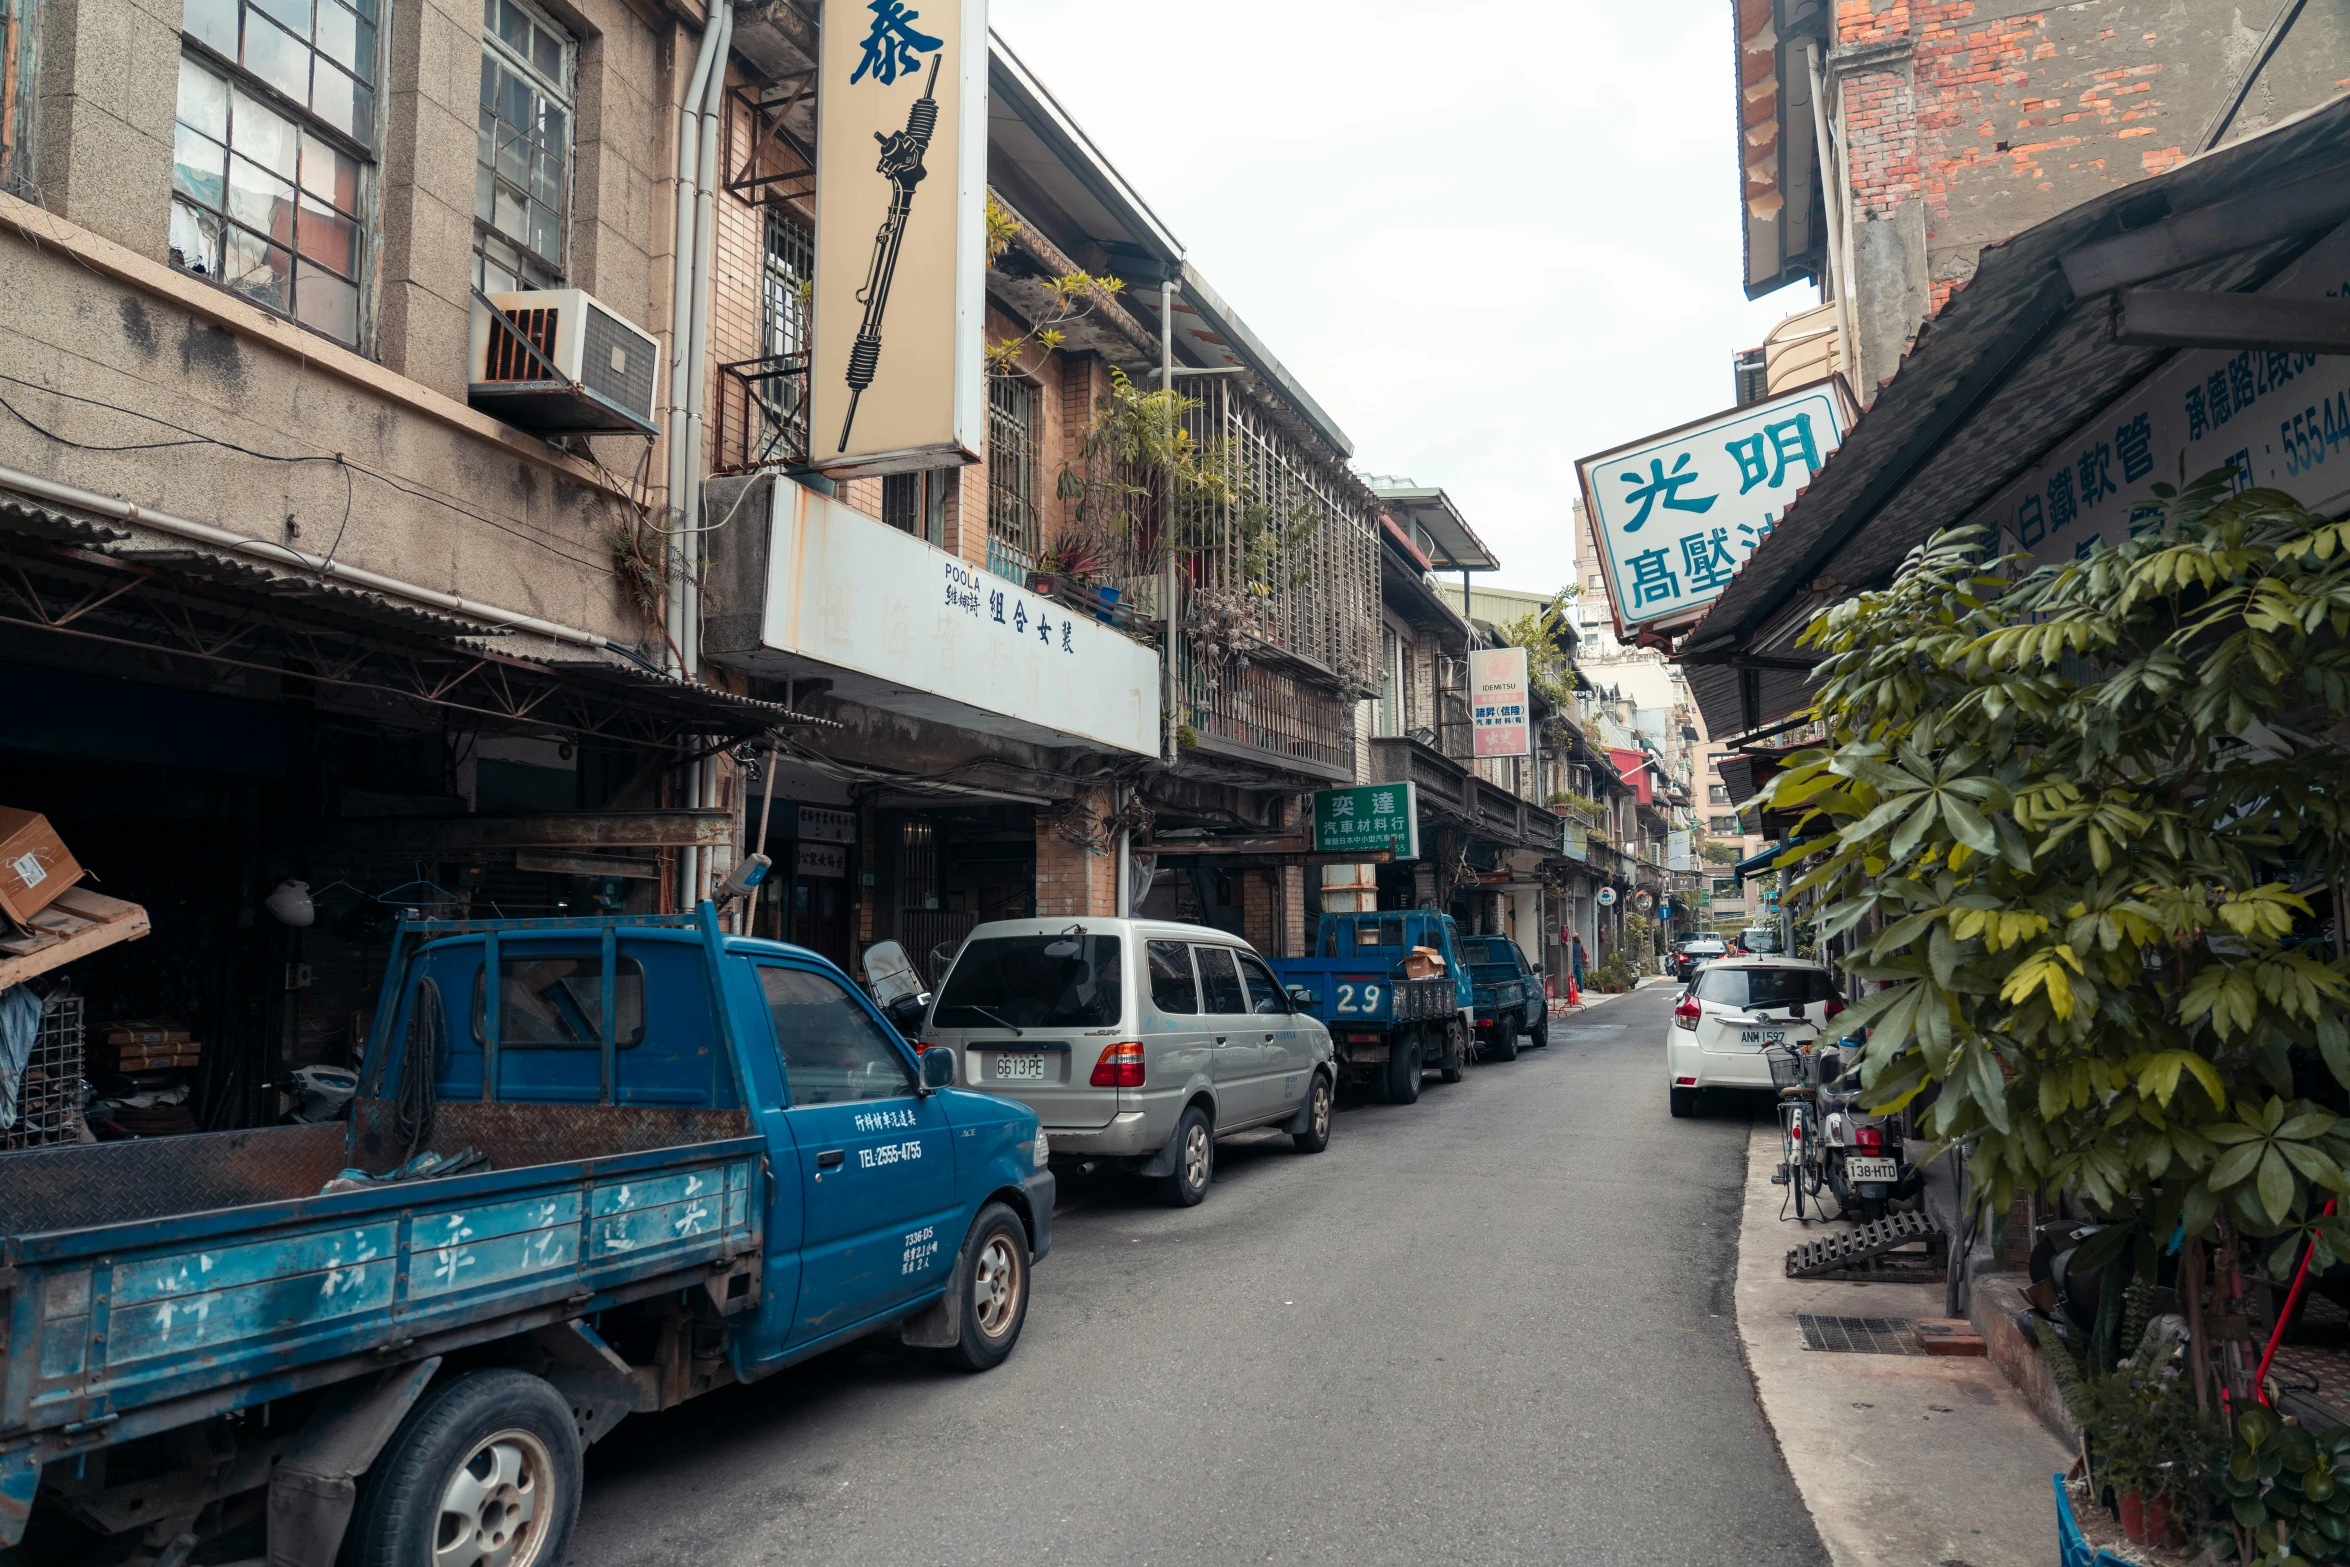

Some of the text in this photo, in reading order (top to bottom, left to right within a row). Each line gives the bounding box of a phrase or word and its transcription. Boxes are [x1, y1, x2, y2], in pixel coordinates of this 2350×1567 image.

[1619, 412, 1822, 533] 光明
[945, 563, 980, 592] POOLA
[989, 588, 1074, 654] 組合女裝
[1482, 683, 1516, 691] IDEMITSU
[1324, 816, 1405, 835] 汽車材料行
[1741, 1031, 1785, 1043] ANM-1597
[997, 1058, 1043, 1076] 6613-PE
[1850, 1165, 1896, 1178] 138-HTD
[905, 1226, 933, 1247] 7336-DS
